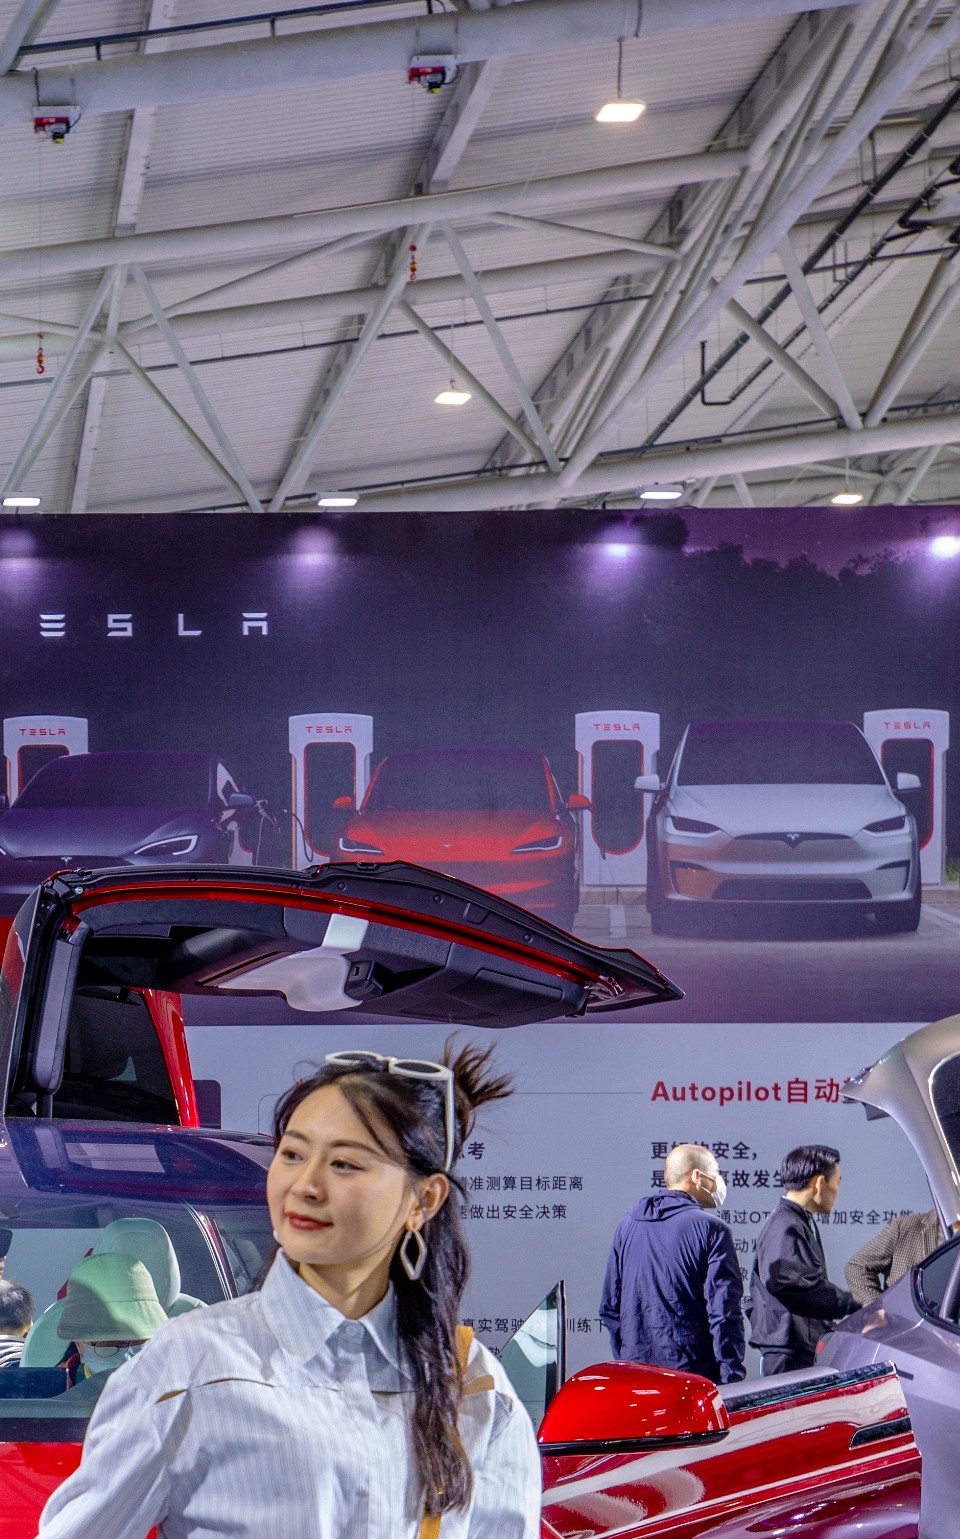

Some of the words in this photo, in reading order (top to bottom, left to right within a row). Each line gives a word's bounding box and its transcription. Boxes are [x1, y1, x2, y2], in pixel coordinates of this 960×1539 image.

[305, 725, 352, 734] TESLA
[593, 723, 641, 731] TESLA
[883, 721, 931, 730] TESLA
[19, 728, 66, 736] TESLA
[650, 1077, 851, 1107] Autopilot自动
